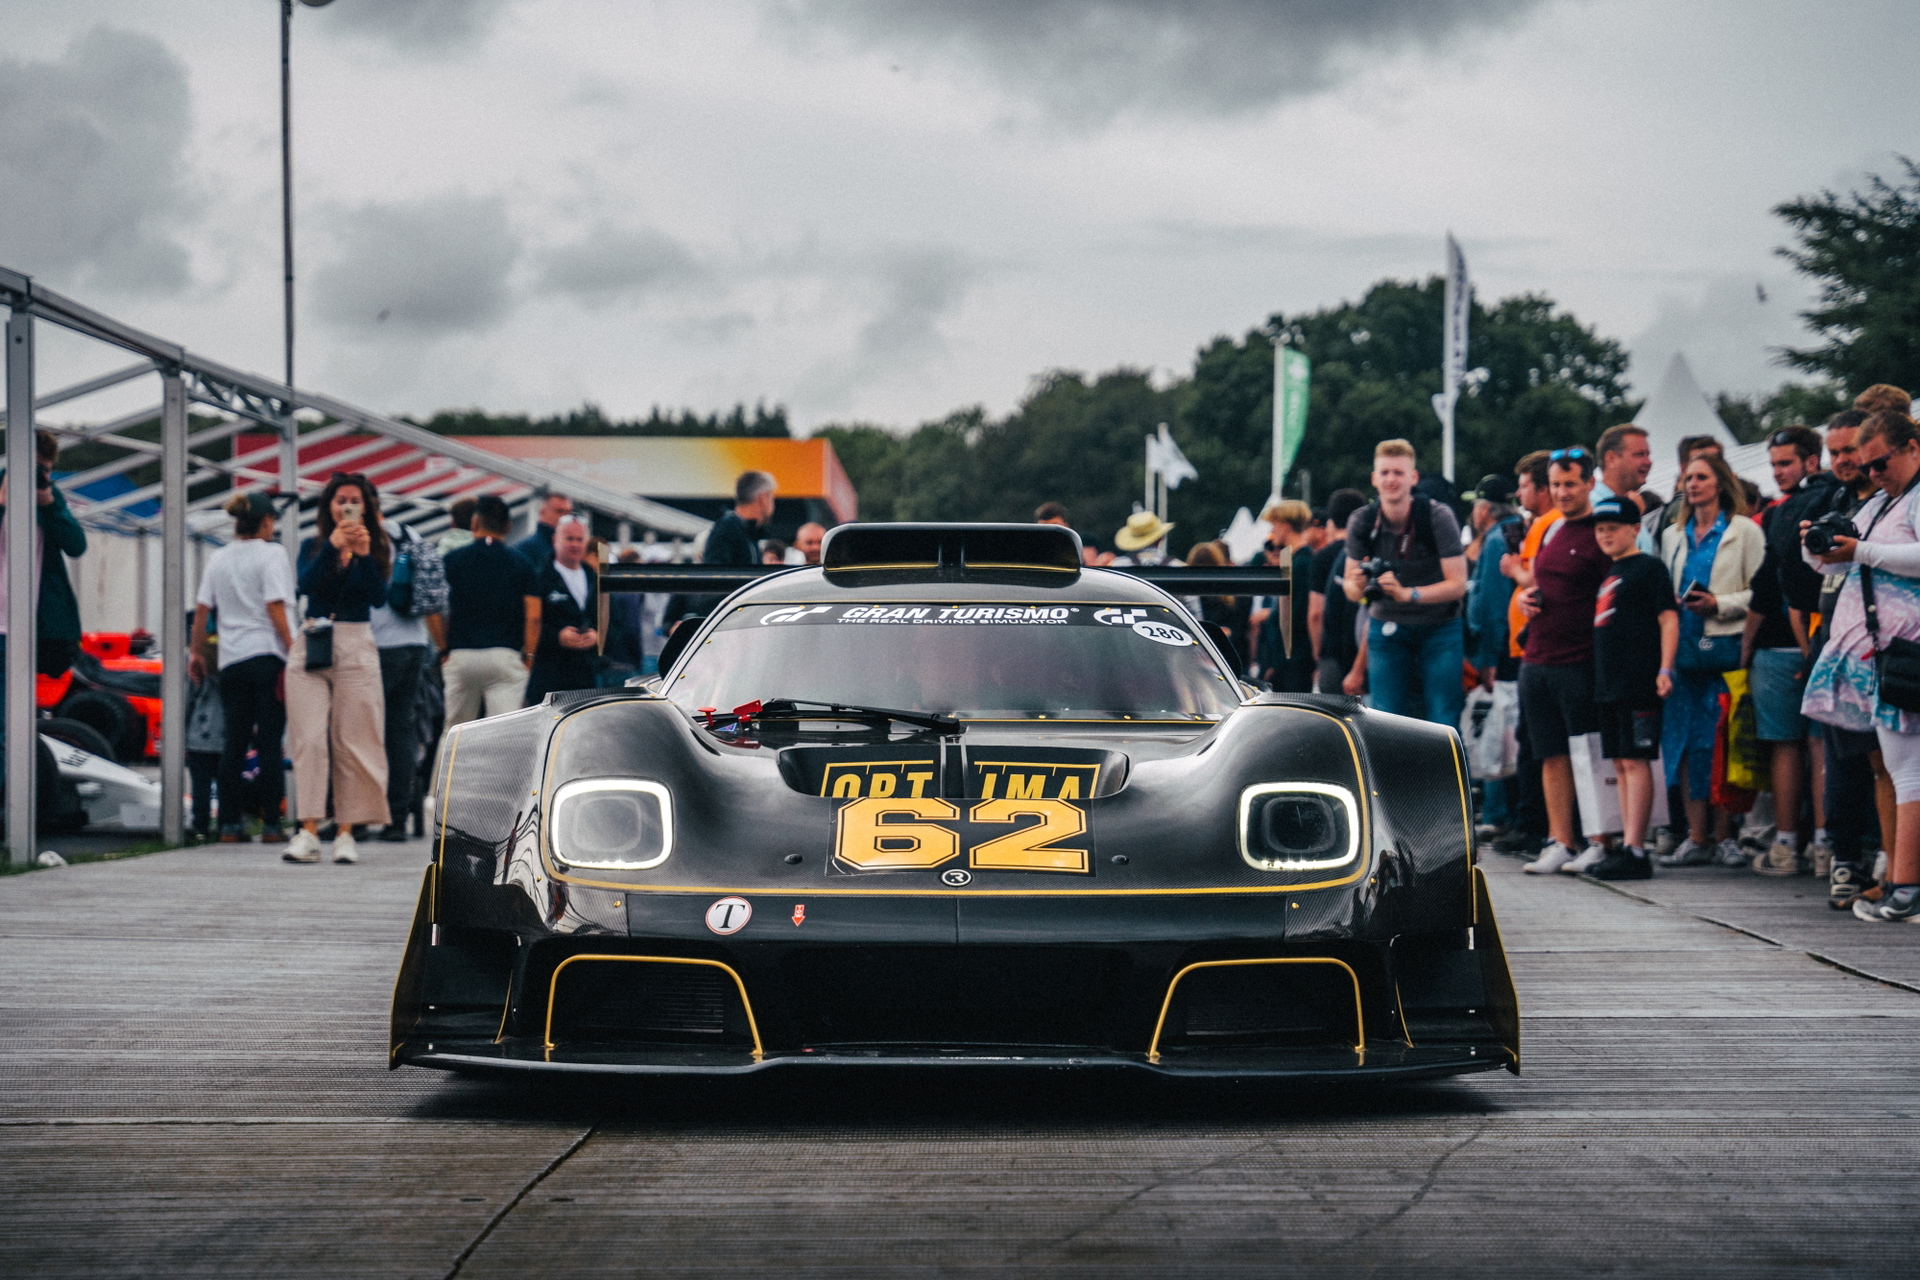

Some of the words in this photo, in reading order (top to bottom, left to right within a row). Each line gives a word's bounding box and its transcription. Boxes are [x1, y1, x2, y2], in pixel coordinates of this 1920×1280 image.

[842, 607, 932, 619] GRAN
[1142, 626, 1185, 641] 280
[835, 797, 1090, 873] 62
[715, 903, 746, 929] T
